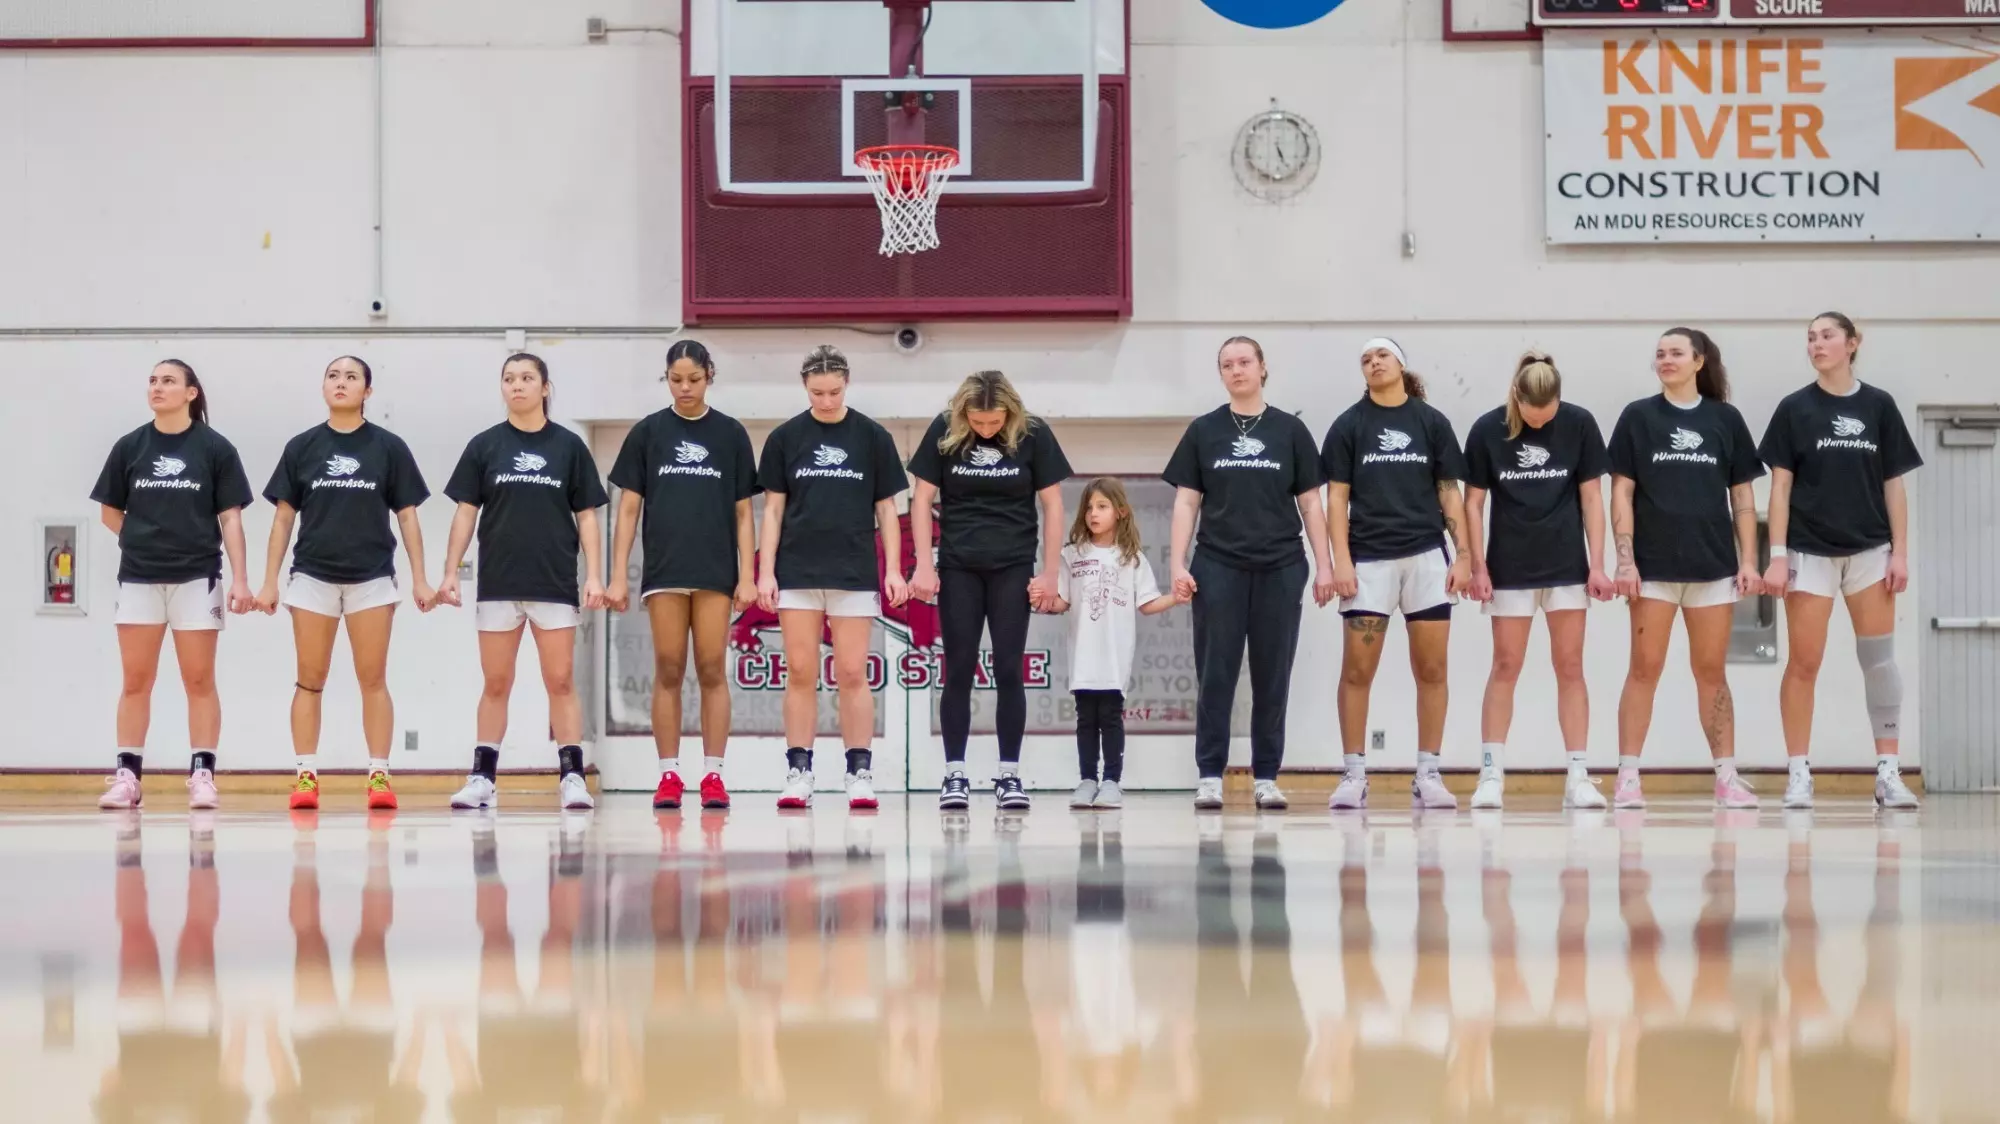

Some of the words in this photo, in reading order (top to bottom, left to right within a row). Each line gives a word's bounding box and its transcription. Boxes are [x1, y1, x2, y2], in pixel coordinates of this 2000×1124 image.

[1755, 0, 1823, 15] SCORE
[1965, 0, 2000, 14] MA
[1602, 38, 1827, 95] KNIFE
[1602, 104, 1831, 160] RIVER
[1557, 170, 1881, 199] CONSTRUCTION
[1574, 213, 1599, 230] AN
[1604, 213, 1647, 230] MDU
[1652, 212, 1768, 230] RESOURCES
[1773, 212, 1866, 230] COMPANY
[735, 651, 888, 691] CHO
[897, 649, 1050, 690] SAE
[1142, 654, 1196, 670] SOCC
